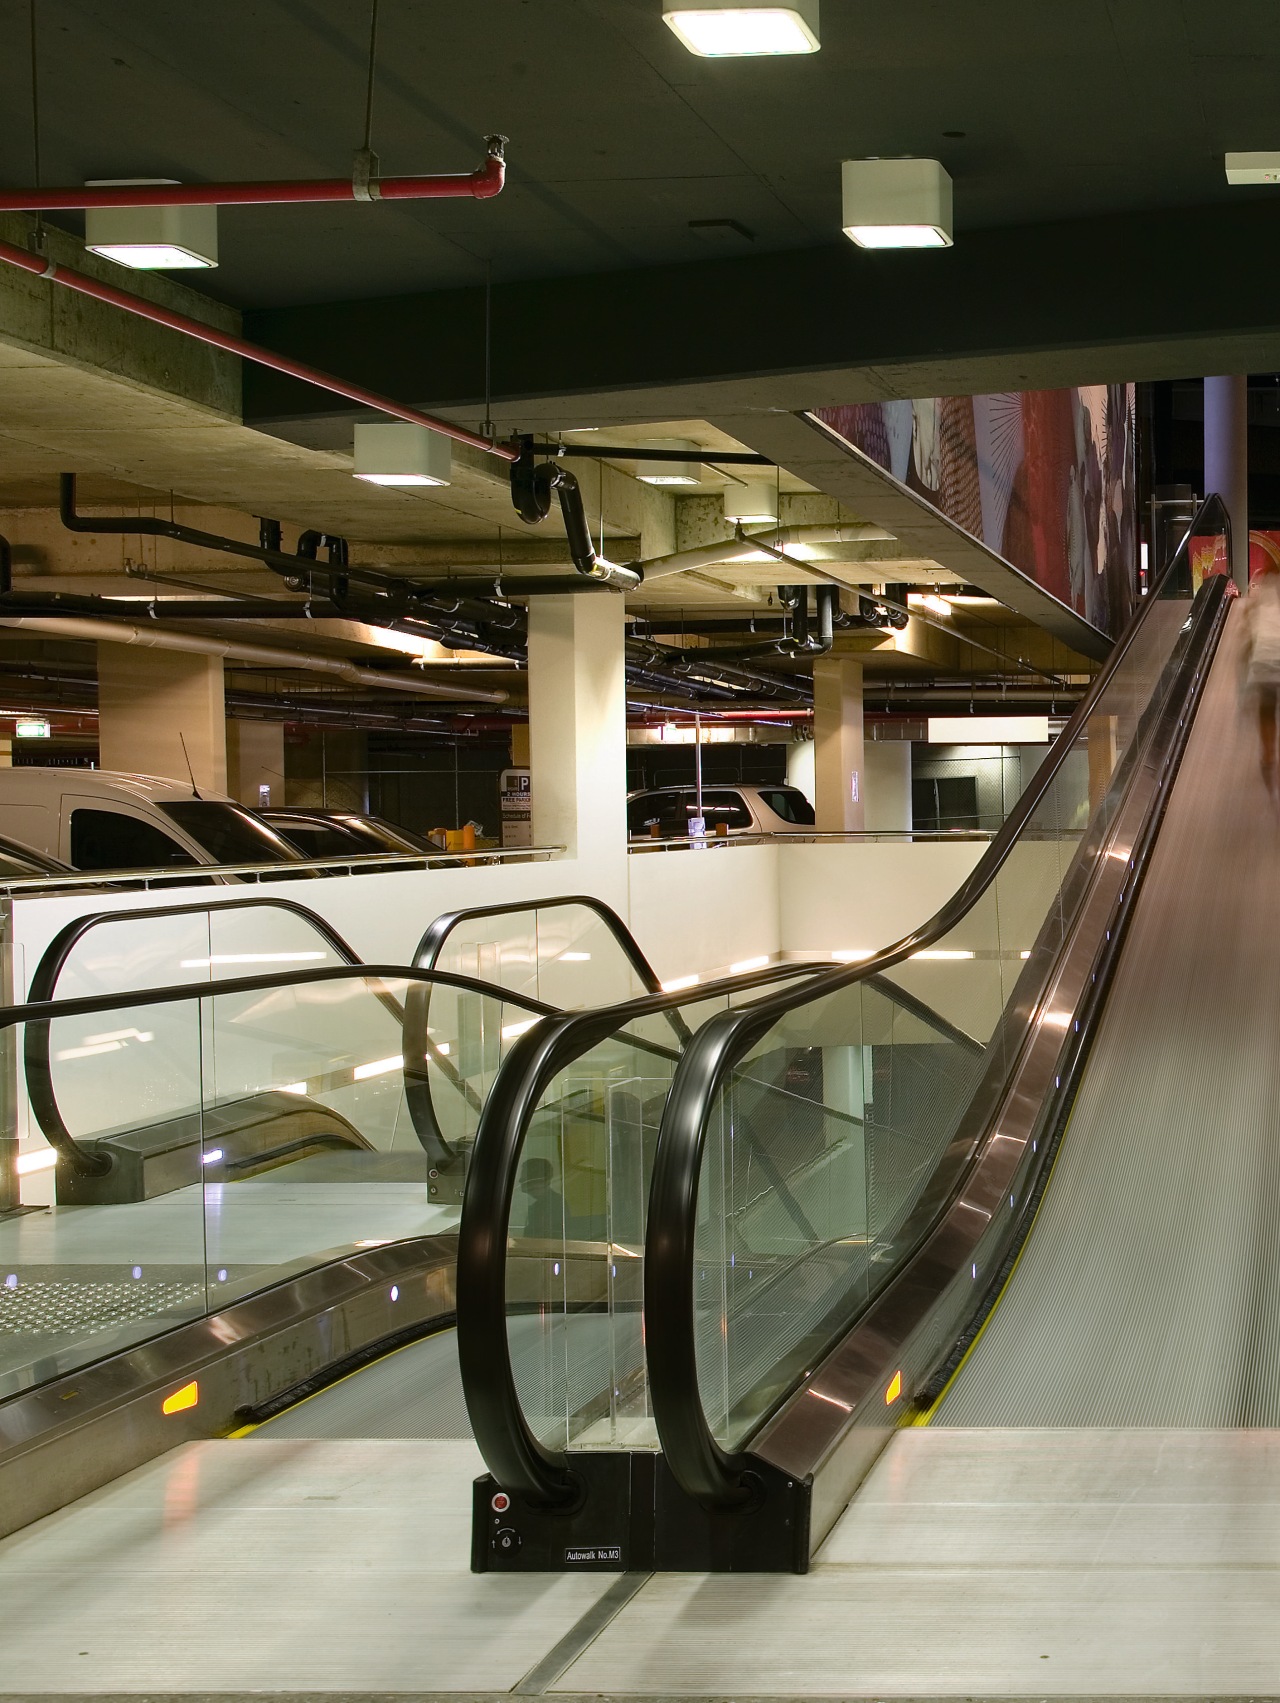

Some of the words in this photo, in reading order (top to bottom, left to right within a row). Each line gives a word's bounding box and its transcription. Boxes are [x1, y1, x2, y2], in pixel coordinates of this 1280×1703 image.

[521, 777, 529, 791] P
[566, 1551, 596, 1560] Autowalk
[598, 1550, 619, 1559] No.M3
